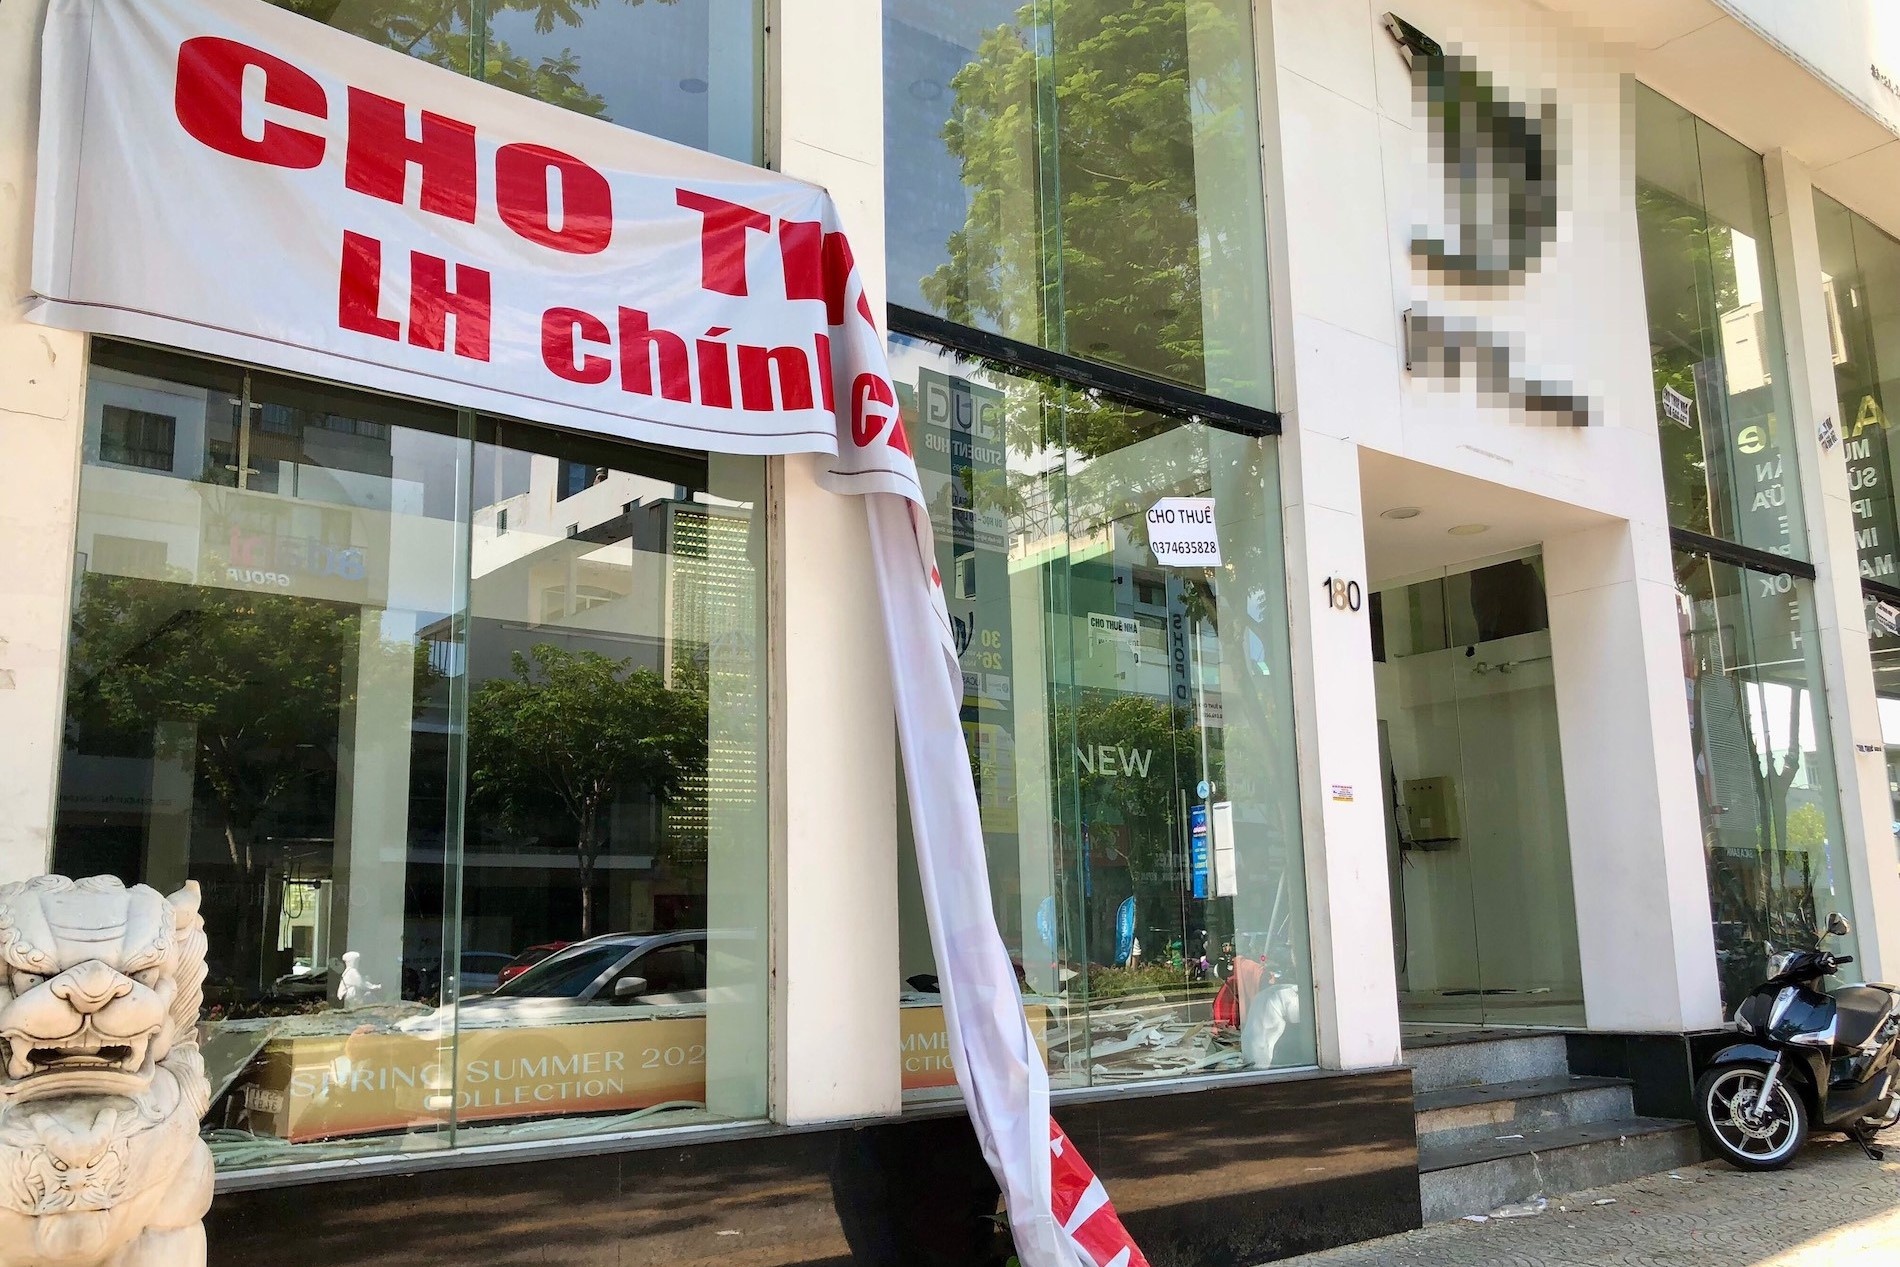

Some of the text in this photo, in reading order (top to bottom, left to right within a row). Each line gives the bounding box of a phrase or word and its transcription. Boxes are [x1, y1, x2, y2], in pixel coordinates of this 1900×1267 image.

[175, 36, 611, 254] CHO
[339, 230, 491, 363] LH
[1147, 505, 1212, 524] CHO THUÊ
[1152, 541, 1217, 554] 0374635828
[1322, 576, 1361, 612] 180
[466, 1050, 625, 1083] SUMMER
[641, 1044, 706, 1070] 202
